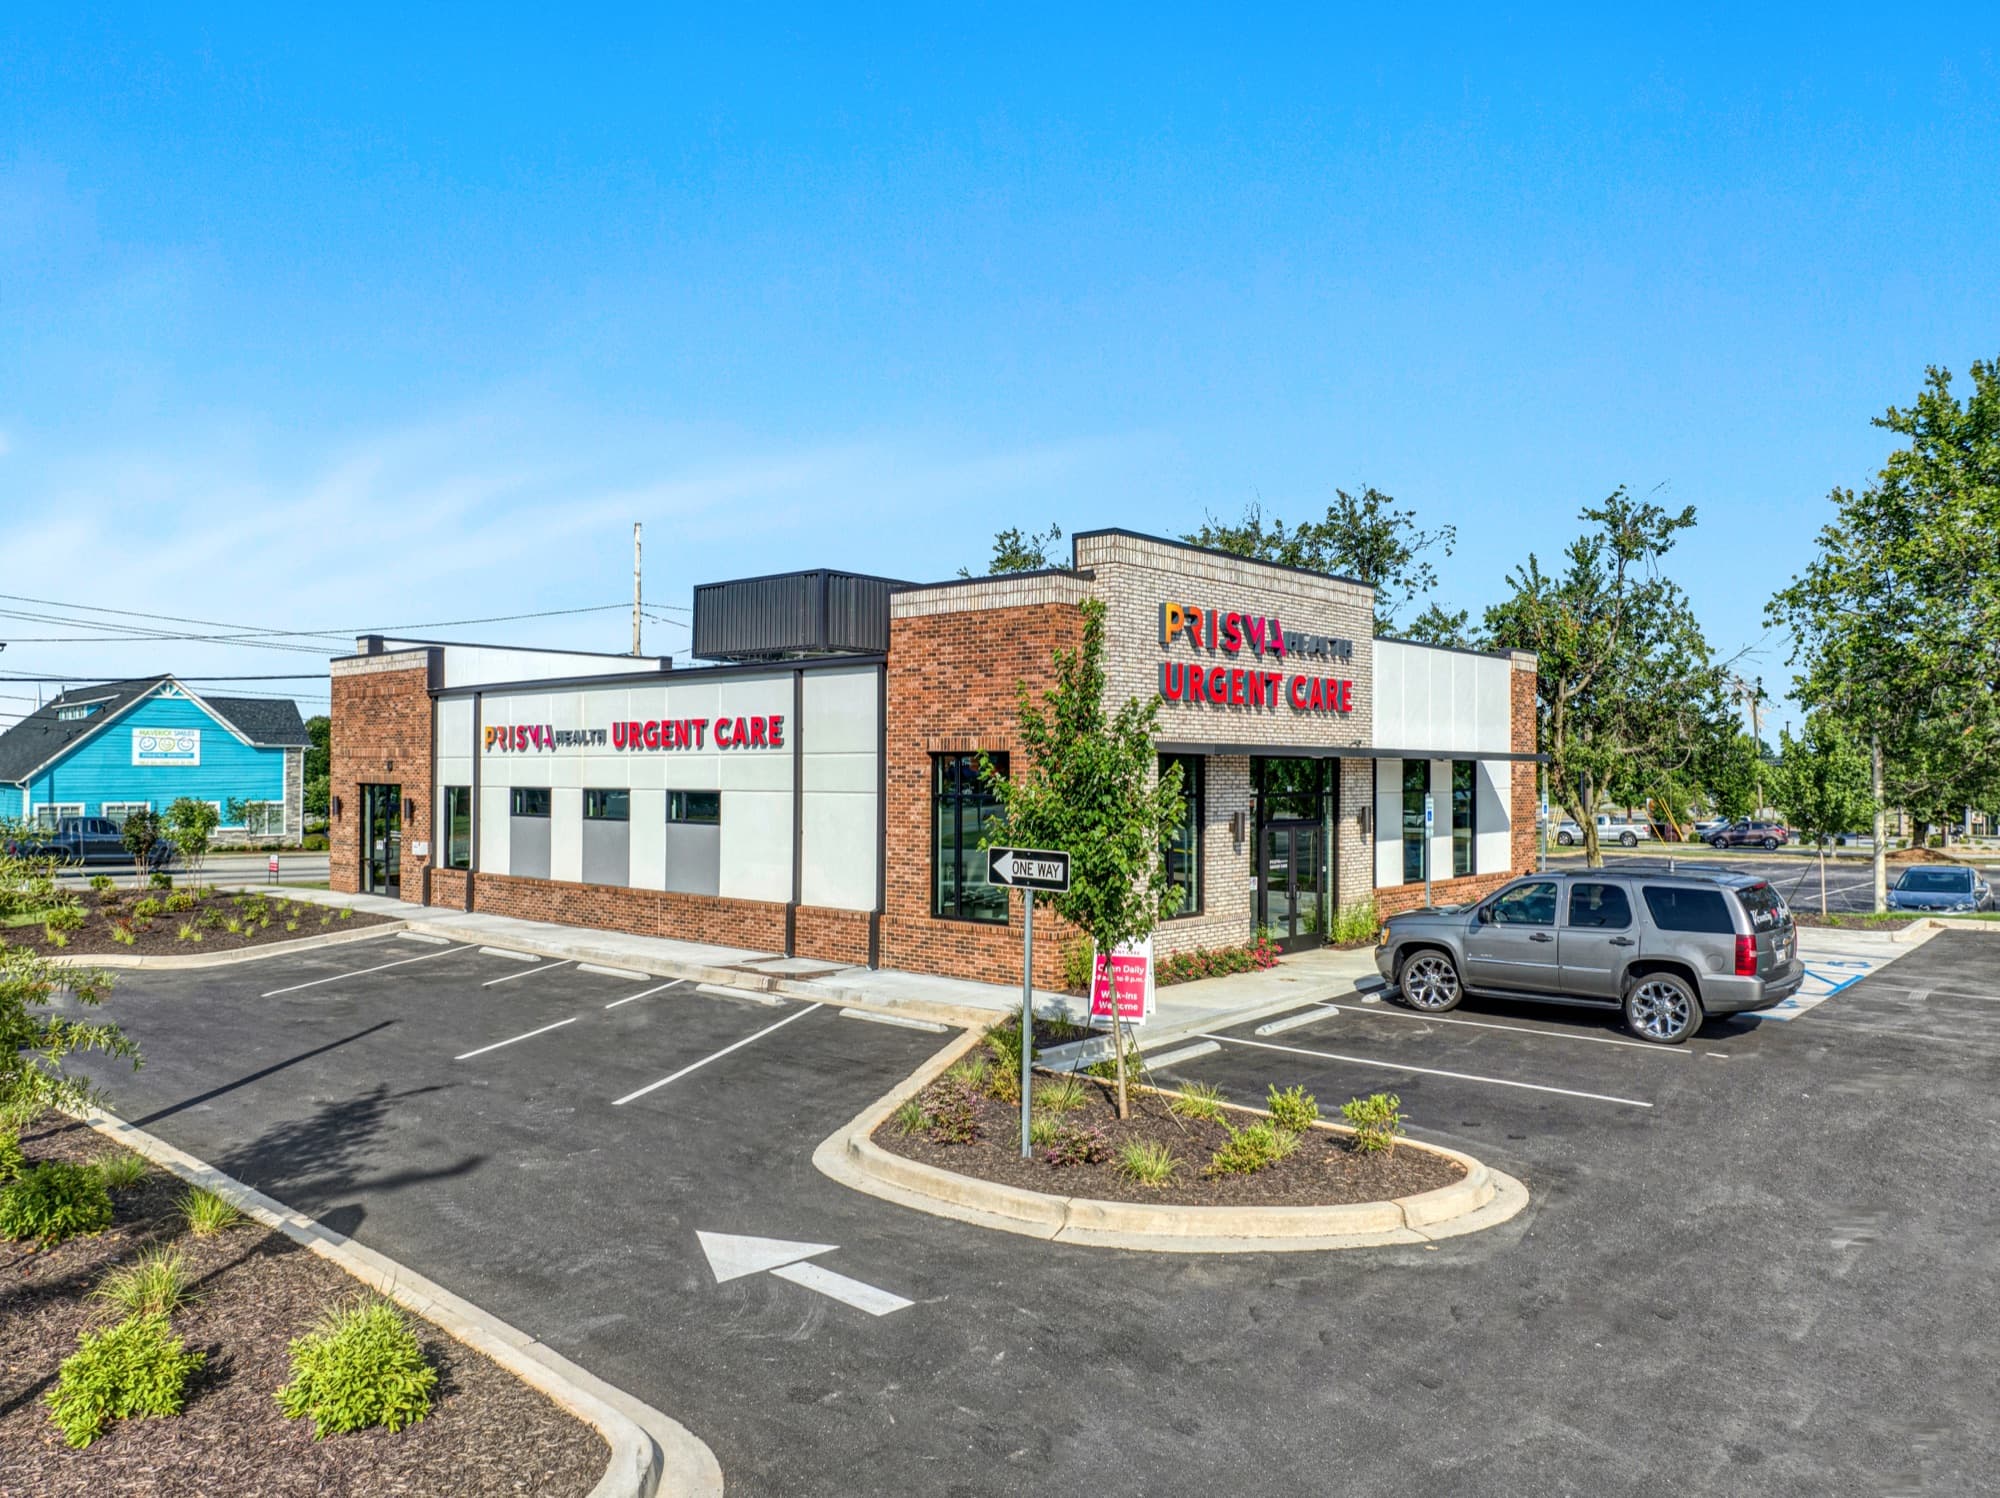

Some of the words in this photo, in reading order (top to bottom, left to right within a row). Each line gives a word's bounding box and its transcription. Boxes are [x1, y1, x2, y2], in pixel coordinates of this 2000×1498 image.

[1159, 602, 1286, 657] PRISMA
[1159, 661, 1283, 707] URGENT
[1287, 675, 1353, 712] CARE
[484, 725, 556, 751] PRISMA
[556, 729, 607, 746] HEALTH
[612, 719, 709, 750] URGENT
[713, 715, 785, 749] CARE
[1012, 861, 1034, 877] ONE
[1038, 863, 1060, 878] WAY
[1123, 965, 1144, 975] Daily
[1101, 990, 1137, 1000] Wk-ins
